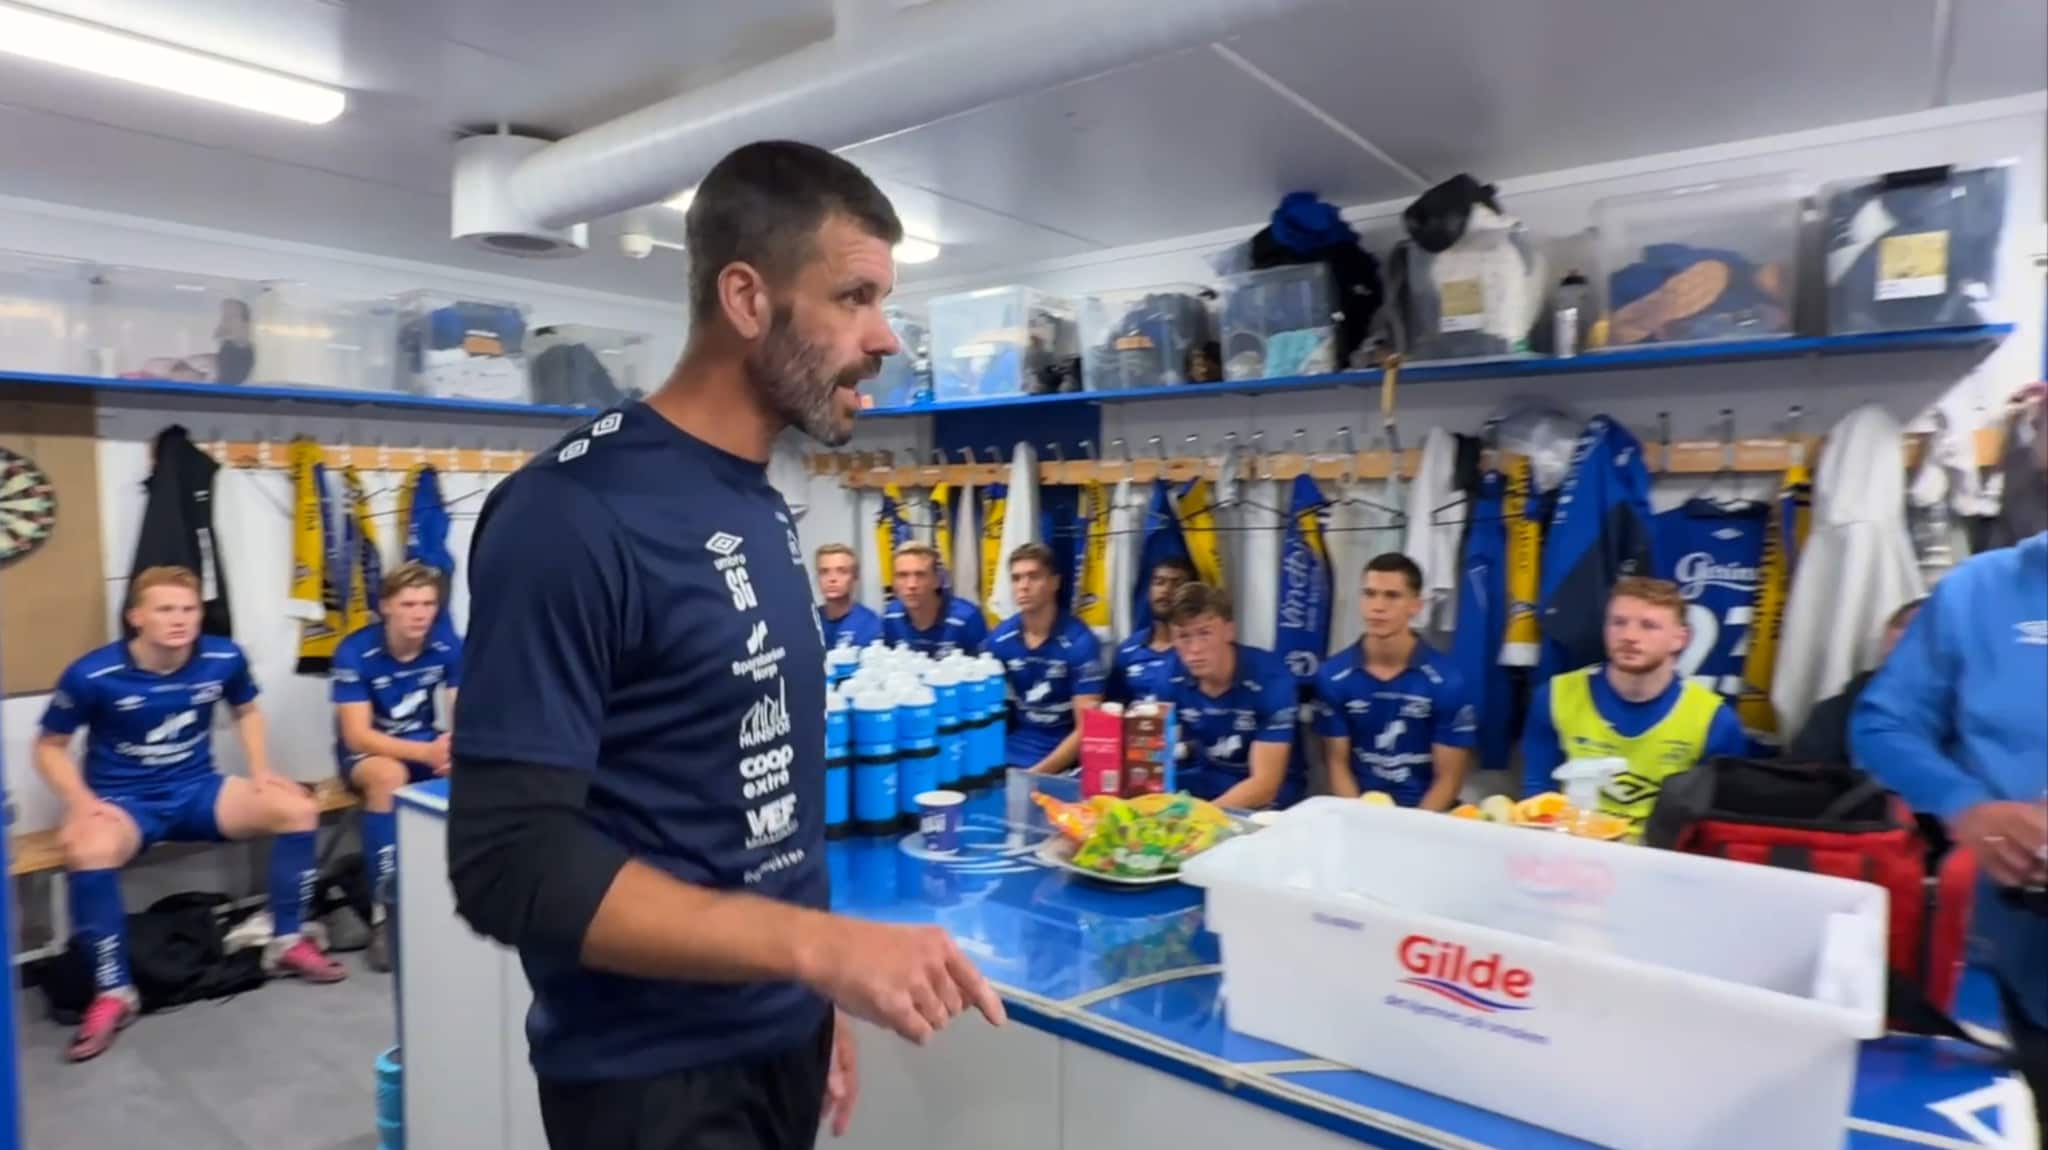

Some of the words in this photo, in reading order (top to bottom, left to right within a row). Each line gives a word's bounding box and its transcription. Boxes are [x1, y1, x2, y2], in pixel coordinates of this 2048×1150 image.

[725, 566, 758, 612] SG
[739, 744, 794, 779] coop
[743, 768, 790, 799] extra
[745, 792, 797, 838] VEF
[1396, 933, 1534, 999] Gilde
